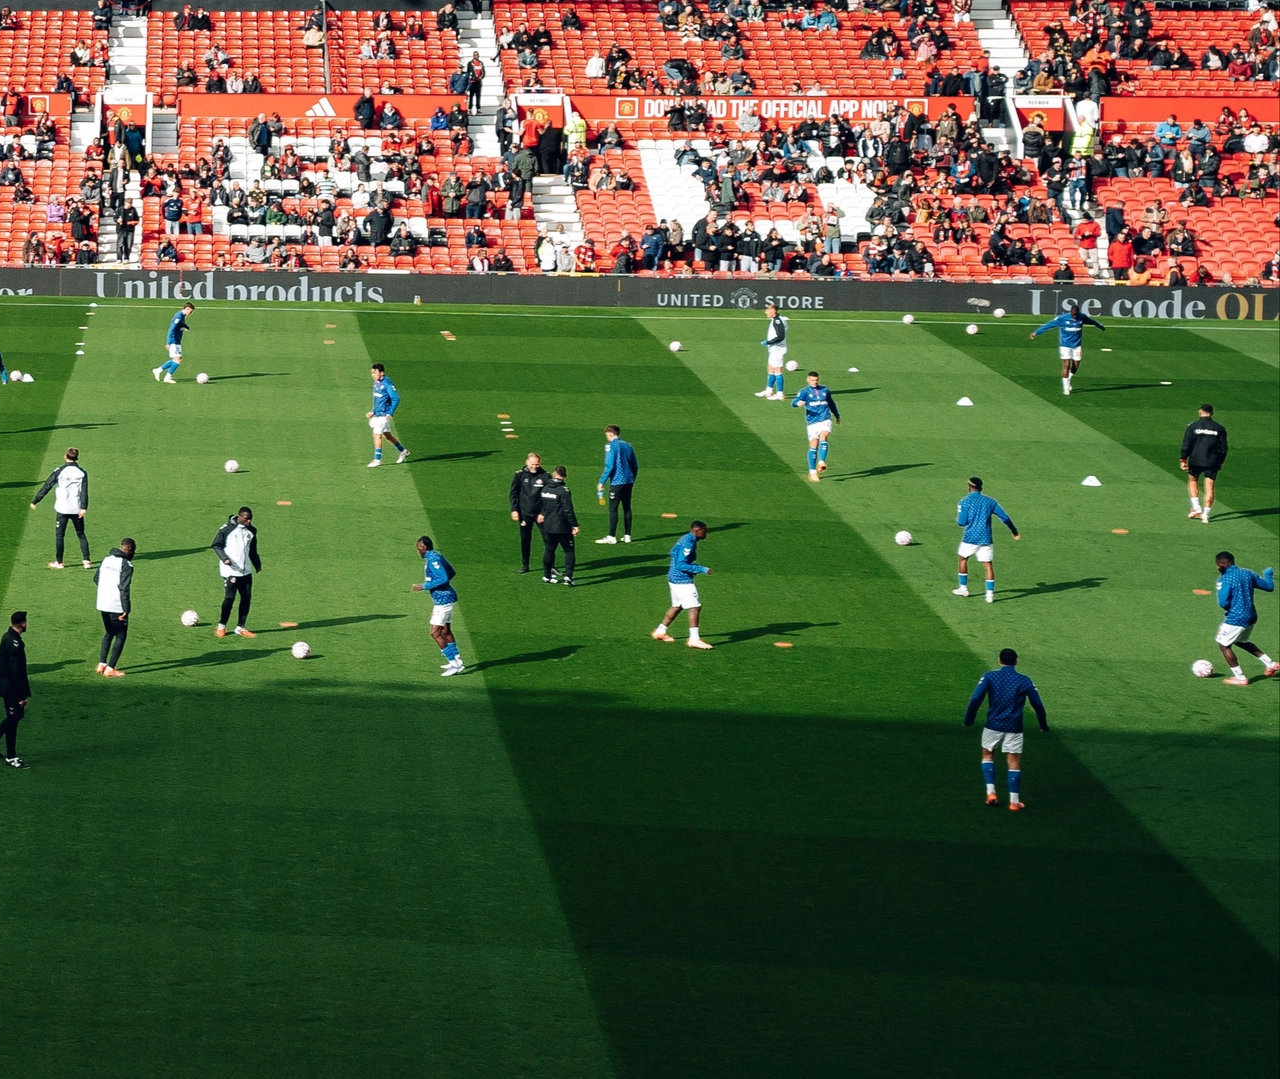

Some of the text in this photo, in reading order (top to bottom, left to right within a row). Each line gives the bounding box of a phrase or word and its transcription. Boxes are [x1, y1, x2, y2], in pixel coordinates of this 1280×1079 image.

[644, 99, 727, 118] DOAD
[730, 99, 759, 118] THE
[761, 99, 827, 119] OFFICIAL
[828, 99, 860, 119] APP
[93, 271, 384, 303] United products
[656, 293, 724, 307] UNITED
[764, 295, 824, 309] STORE
[1029, 289, 1280, 321] Use code OL
